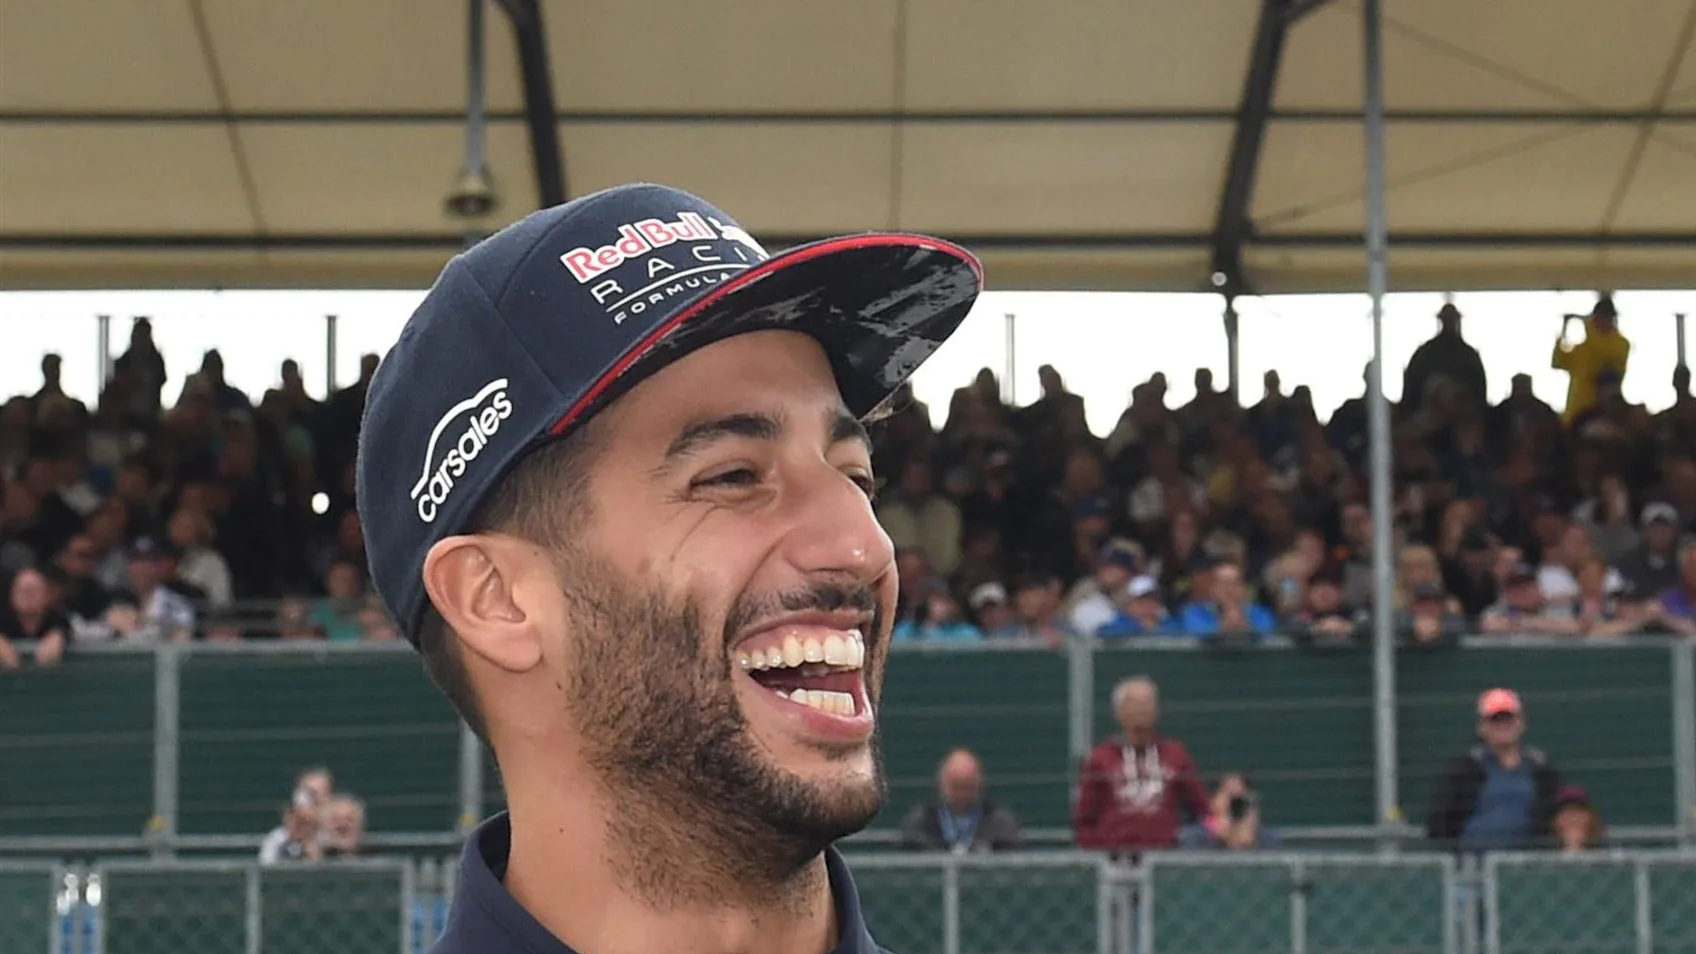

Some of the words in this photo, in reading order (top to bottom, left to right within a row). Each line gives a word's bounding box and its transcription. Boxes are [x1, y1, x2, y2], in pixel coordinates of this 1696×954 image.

[590, 245, 767, 304] RACI
[614, 272, 731, 324] FORMULA
[418, 391, 513, 523] carsales
